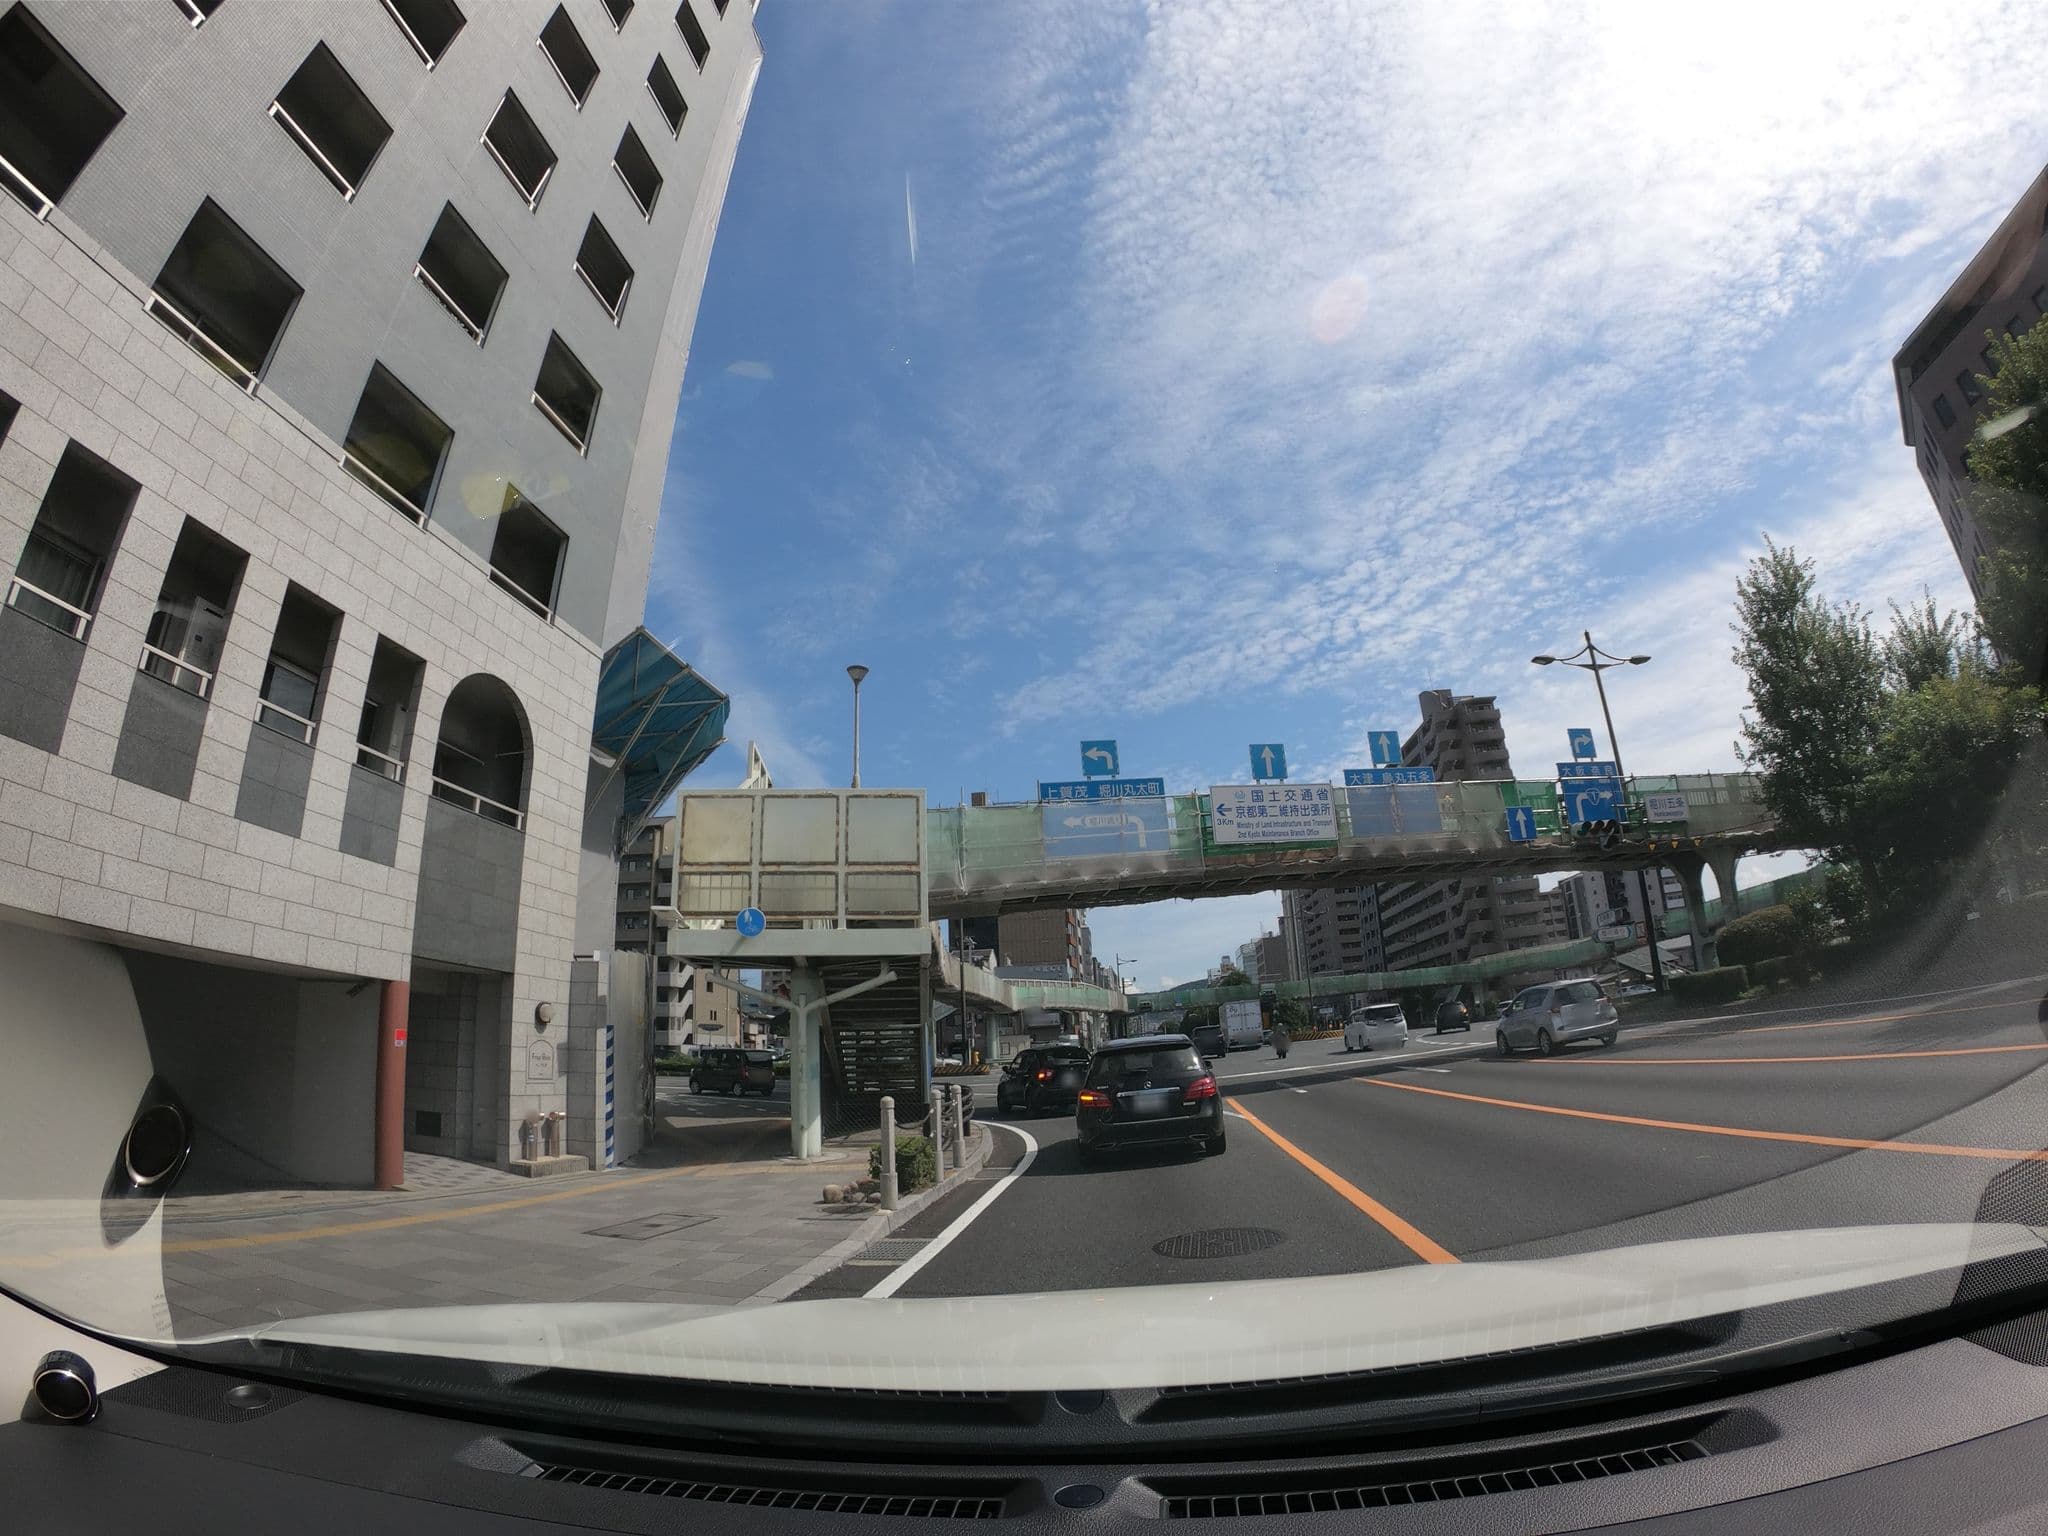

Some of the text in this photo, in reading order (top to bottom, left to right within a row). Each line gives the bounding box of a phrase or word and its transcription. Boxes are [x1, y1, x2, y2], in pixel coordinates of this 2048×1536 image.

[1350, 772, 1373, 785] 大津
[1045, 781, 1160, 800] 上賀茂 堀川丸太町
[1251, 788, 1329, 803] 国土交通省
[1235, 803, 1331, 819] 京都第二維持出張所
